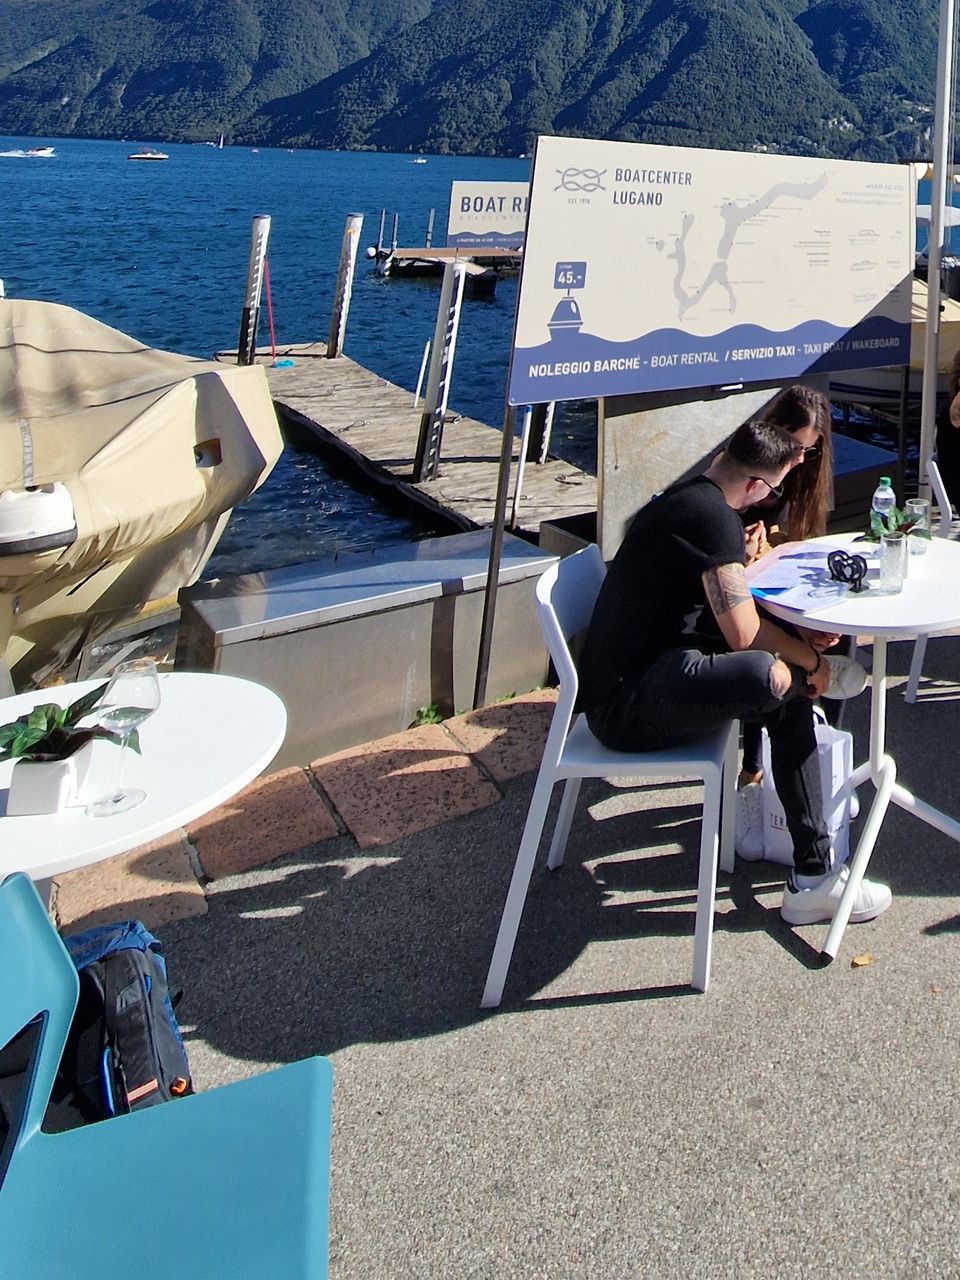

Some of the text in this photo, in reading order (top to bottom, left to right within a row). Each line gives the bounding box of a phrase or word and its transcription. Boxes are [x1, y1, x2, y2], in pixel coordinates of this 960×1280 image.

[615, 168, 692, 186] BOATCENTER
[460, 196, 506, 213] BOAT
[613, 191, 664, 206] LUGANO
[557, 270, 583, 284] 45.-
[528, 360, 591, 378] NOLEGGIO
[593, 355, 640, 373] BARCHE
[651, 350, 678, 368] BOAT
[681, 351, 719, 365] RENTAL
[731, 346, 774, 361] SERVIZIO
[776, 345, 796, 357] TAXI
[803, 343, 822, 355] TAXI
[823, 341, 845, 353] BOAT
[852, 337, 900, 351] WAKEBOARD
